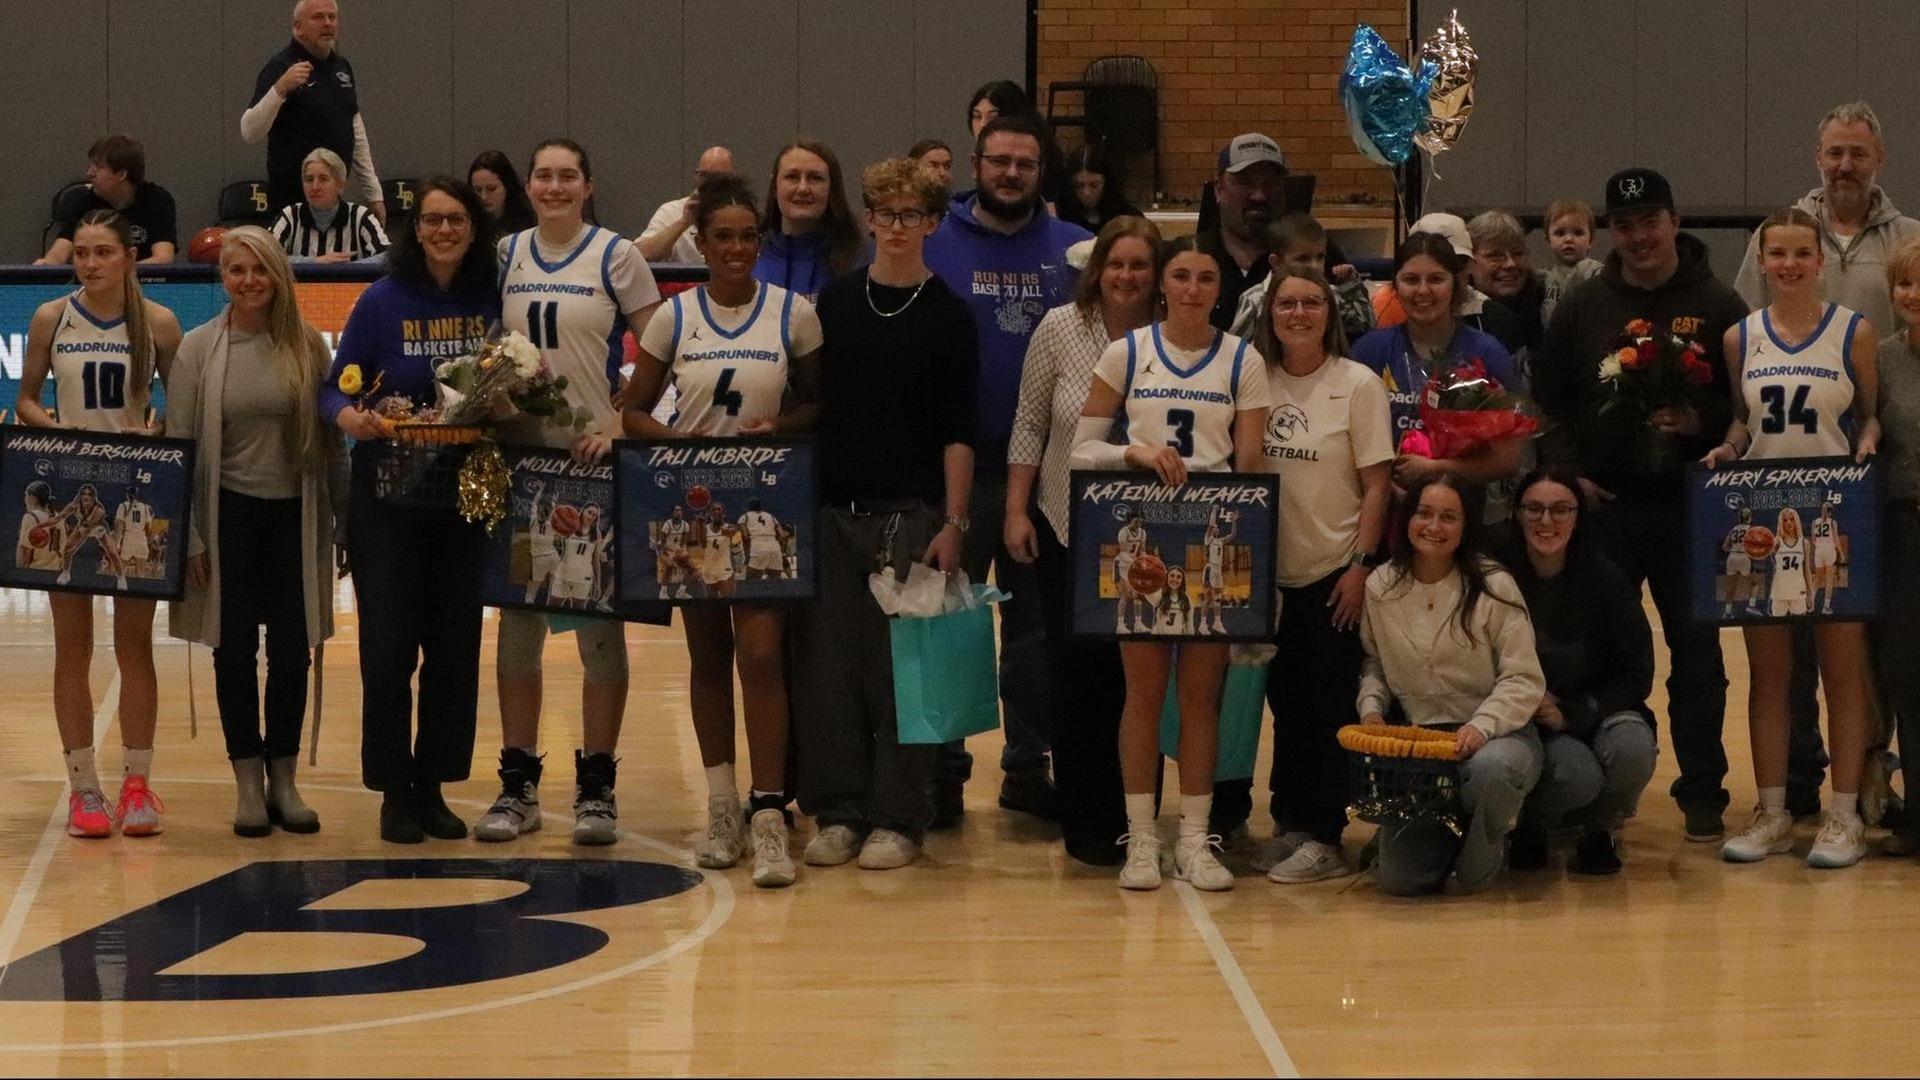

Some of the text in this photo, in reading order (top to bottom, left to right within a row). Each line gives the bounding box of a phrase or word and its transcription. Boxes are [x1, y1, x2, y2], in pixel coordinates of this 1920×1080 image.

[506, 283, 596, 297] ROADRUNNERS
[527, 301, 559, 349] 11
[1672, 316, 1701, 333] CAT
[682, 349, 780, 363] ROADRUNNERS
[1747, 366, 1838, 381] ROADRUNNERS
[82, 361, 126, 410] 10
[712, 368, 742, 416] 4
[1134, 389, 1231, 404] ROADRUNNERS
[1760, 385, 1818, 434] 34
[1166, 409, 1194, 457] 3
[7, 436, 183, 467] HANNAH BERSCHAUER
[648, 446, 792, 469] TALI MCBRIDE
[514, 455, 571, 475] MOLLY
[136, 467, 152, 484] LB
[761, 470, 777, 487] LB
[1705, 463, 1871, 488] AVERY SPIKERMAN
[1083, 481, 1269, 509] KATELYNN WEAVER
[1827, 490, 1842, 505] LB
[1815, 524, 1829, 537] 32
[576, 543, 587, 556] 11
[1782, 556, 1799, 570] 34
[0, 859, 704, 1001] B
